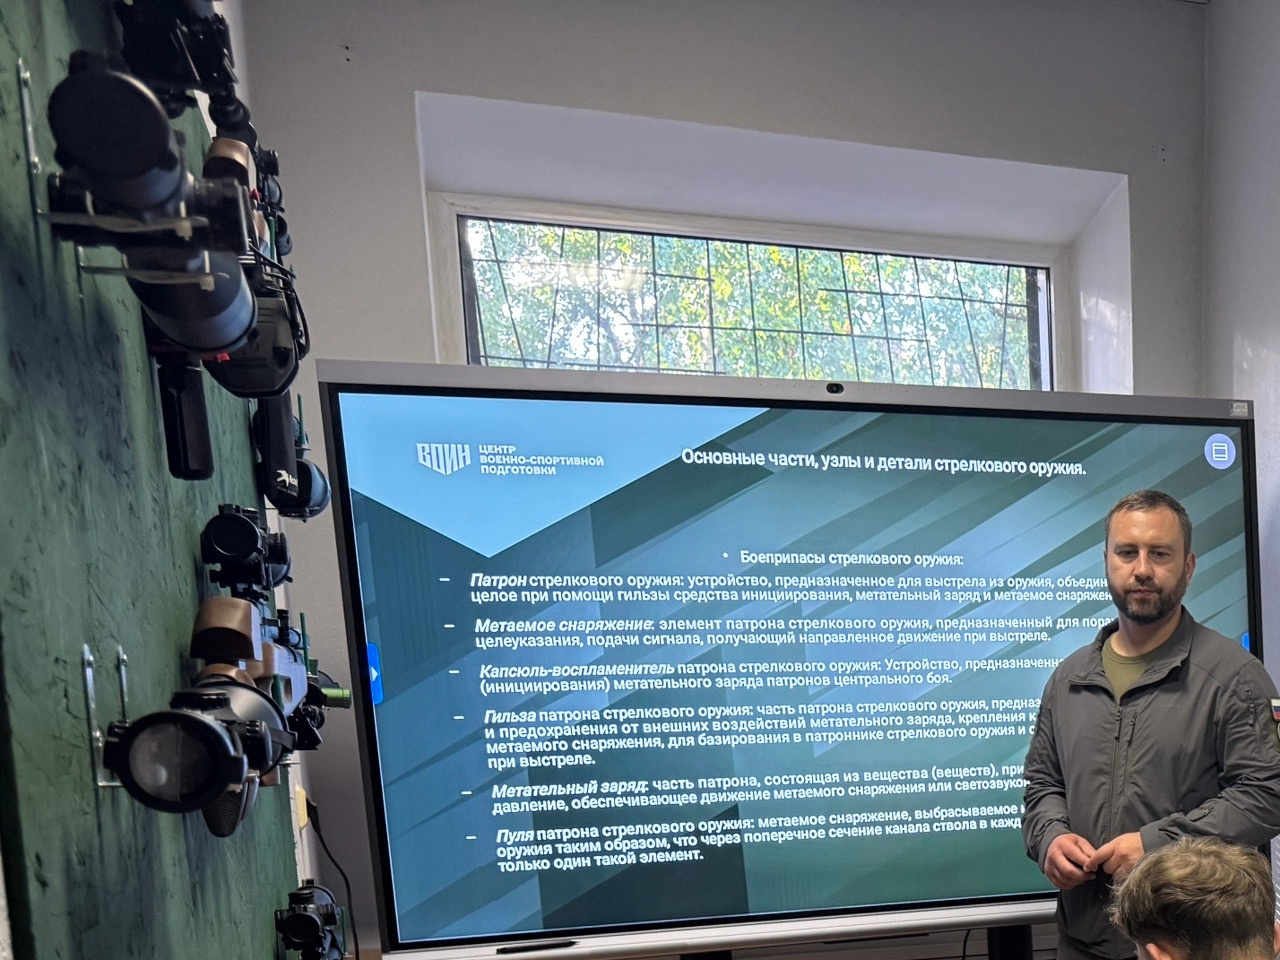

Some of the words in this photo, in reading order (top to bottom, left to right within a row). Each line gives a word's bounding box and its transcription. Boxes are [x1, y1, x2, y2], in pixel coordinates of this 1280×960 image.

[416, 443, 472, 476] ВОИН
[479, 444, 516, 454] ЦЕНТР
[480, 455, 604, 466] ВОЕННО-СПОРТИВНОЙ
[481, 465, 557, 476] ПОДГОТОВКИ
[682, 449, 765, 464] Основные
[768, 453, 818, 468] части,
[820, 455, 861, 470] узлы
[864, 456, 874, 467] и
[877, 456, 932, 471] детали
[934, 458, 1027, 475] стрелкового
[1029, 461, 1086, 477] оружия.
[740, 550, 825, 567] Боеприпасы
[828, 553, 911, 567] стрелкового
[914, 553, 963, 568] оружия:
[470, 573, 527, 589] Патрон
[528, 575, 623, 589] стрелкового
[626, 575, 684, 589] оружия:
[687, 573, 772, 589] устройство,
[774, 575, 895, 590] предназначенное
[897, 576, 921, 589] для
[925, 576, 986, 591] выстрела
[989, 576, 1005, 588] из
[1007, 577, 1054, 591] оружия,
[1056, 575, 1108, 591] объедин
[470, 590, 518, 604] целое
[520, 590, 549, 604] при
[552, 590, 613, 603] помощи
[617, 590, 670, 601] гильзы
[673, 590, 738, 604] средства
[741, 590, 853, 604] инициирования,
[856, 587, 941, 601] метательный
[944, 590, 982, 604] заряд
[982, 590, 991, 601] и
[994, 590, 1053, 602] метаемое
[474, 617, 556, 631] Метаемое
[558, 619, 654, 634] снаряжение:
[659, 619, 722, 630] элемент
[726, 619, 785, 633] патрона
[788, 618, 876, 633] стрелкового
[880, 618, 932, 632] оружия,
[936, 615, 1052, 632] предназначенный
[1056, 617, 1079, 631] для
[1082, 617, 1115, 631] пора
[475, 635, 583, 650] целеуказания,
[586, 634, 639, 648] подачи
[642, 633, 704, 647] сигнала,
[706, 630, 795, 648] получающий
[799, 632, 894, 647] направленное
[896, 631, 961, 645] движение
[964, 631, 986, 646] при
[989, 631, 1051, 645] выстреле.
[479, 661, 675, 678] Капсюль-воспламенитель
[677, 662, 736, 677] патрона
[738, 661, 825, 676] стрелкового
[829, 660, 881, 675] оружия:
[884, 656, 962, 674] Устройство,
[480, 677, 610, 696] (инициирования)
[613, 677, 712, 690] метательного
[714, 676, 763, 691] заряда
[766, 675, 830, 690] патронов
[834, 673, 923, 689] центрального
[926, 670, 952, 684] боя.
[484, 708, 536, 723] Гильза
[538, 709, 601, 724] патрона
[602, 706, 694, 723] стрелкового
[698, 705, 753, 720] оружия:
[756, 703, 795, 716] часть
[798, 702, 853, 718] патрона
[856, 700, 937, 716] стрелкового
[940, 699, 989, 714] оружия,
[484, 727, 495, 739] и
[499, 723, 618, 741] предохранения
[620, 722, 639, 734] от
[642, 720, 709, 733] внешних
[712, 715, 806, 733] воздействий
[810, 715, 903, 728] метательного
[906, 713, 955, 729] заряда,
[958, 711, 1025, 727] крепления
[486, 739, 568, 753] метаемого
[571, 736, 665, 753] снаряжения,
[667, 735, 695, 749] для
[698, 730, 790, 749] базирования
[793, 732, 802, 743] в
[805, 729, 884, 746] патроннике
[886, 726, 966, 743] стрелкового
[970, 725, 1015, 741] оружия
[1018, 725, 1026, 736] и
[488, 756, 515, 771] при
[519, 753, 595, 770] выстреле.
[491, 780, 598, 798] Метательный
[600, 780, 649, 796] заряд:
[652, 778, 694, 791] часть
[698, 775, 761, 792] патрона,
[764, 772, 840, 788] состоящая
[843, 771, 859, 783] из
[864, 768, 928, 784] вещества
[931, 763, 999, 782] (веществ),
[492, 798, 569, 815] давление,
[571, 790, 697, 812] обеспечивающее
[700, 789, 770, 805] движение
[773, 785, 845, 800] метаемого
[848, 782, 925, 799] снаряжения
[928, 780, 952, 793] или
[496, 827, 534, 845] Пуля
[537, 826, 599, 843] патрона
[602, 821, 695, 840] стрелкового
[698, 817, 755, 835] оружия:
[758, 814, 826, 828] метаемое
[829, 809, 912, 828] снаряжение,
[914, 801, 1018, 823] выбрасываемое
[496, 843, 553, 860] оружия
[554, 840, 601, 854] таким
[604, 834, 671, 854] образом,
[672, 835, 697, 847] что
[700, 832, 741, 849] через
[743, 827, 826, 846] поперечное
[828, 824, 882, 838] сечение
[885, 822, 930, 835] канала
[932, 819, 977, 833] ствола
[979, 818, 987, 830] в
[990, 816, 1022, 832] кажд
[497, 858, 550, 872] только
[553, 855, 591, 871] один
[593, 850, 636, 866] такой
[639, 848, 704, 863] элемент.
